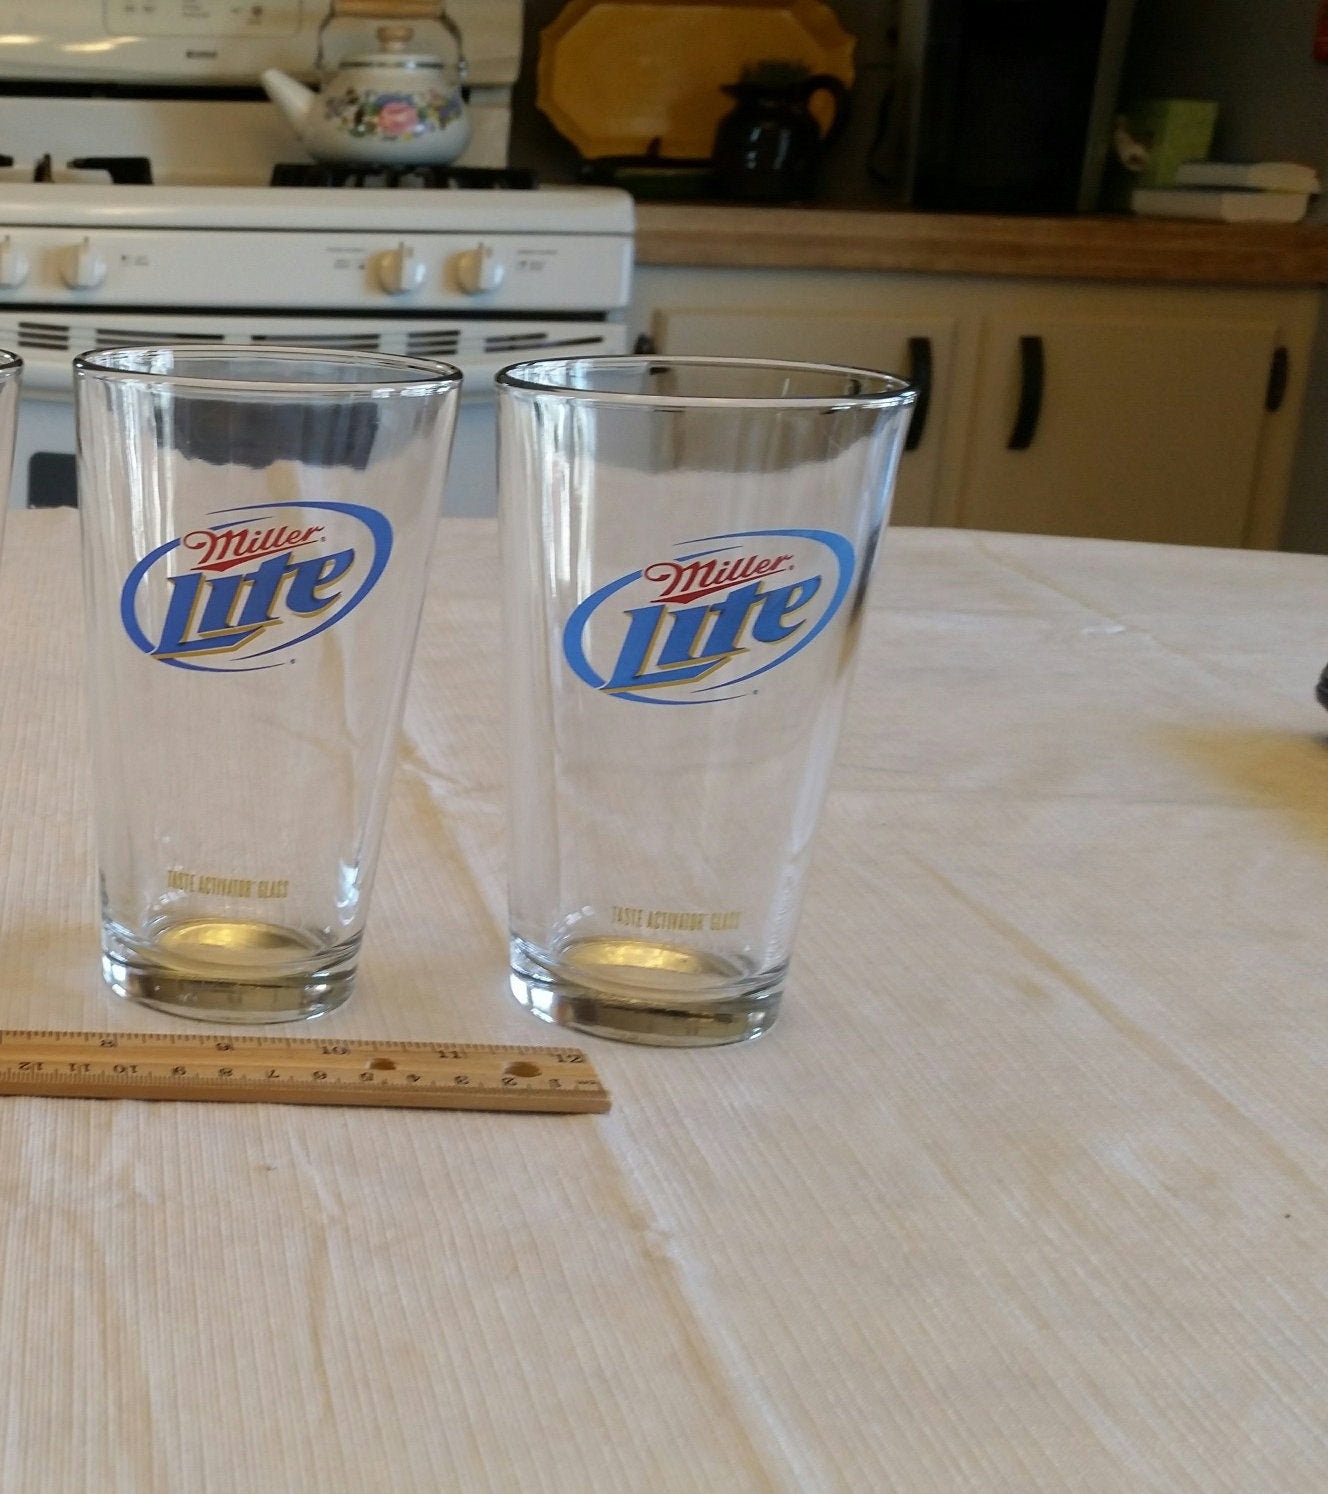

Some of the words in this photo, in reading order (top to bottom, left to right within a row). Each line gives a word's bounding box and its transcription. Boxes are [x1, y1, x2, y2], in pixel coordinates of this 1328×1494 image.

[182, 525, 325, 565] Miller
[643, 554, 794, 597] Miller
[150, 548, 355, 660] Lite
[599, 575, 821, 695] Lite
[167, 870, 196, 893] TASTE
[611, 905, 643, 928] TASTE
